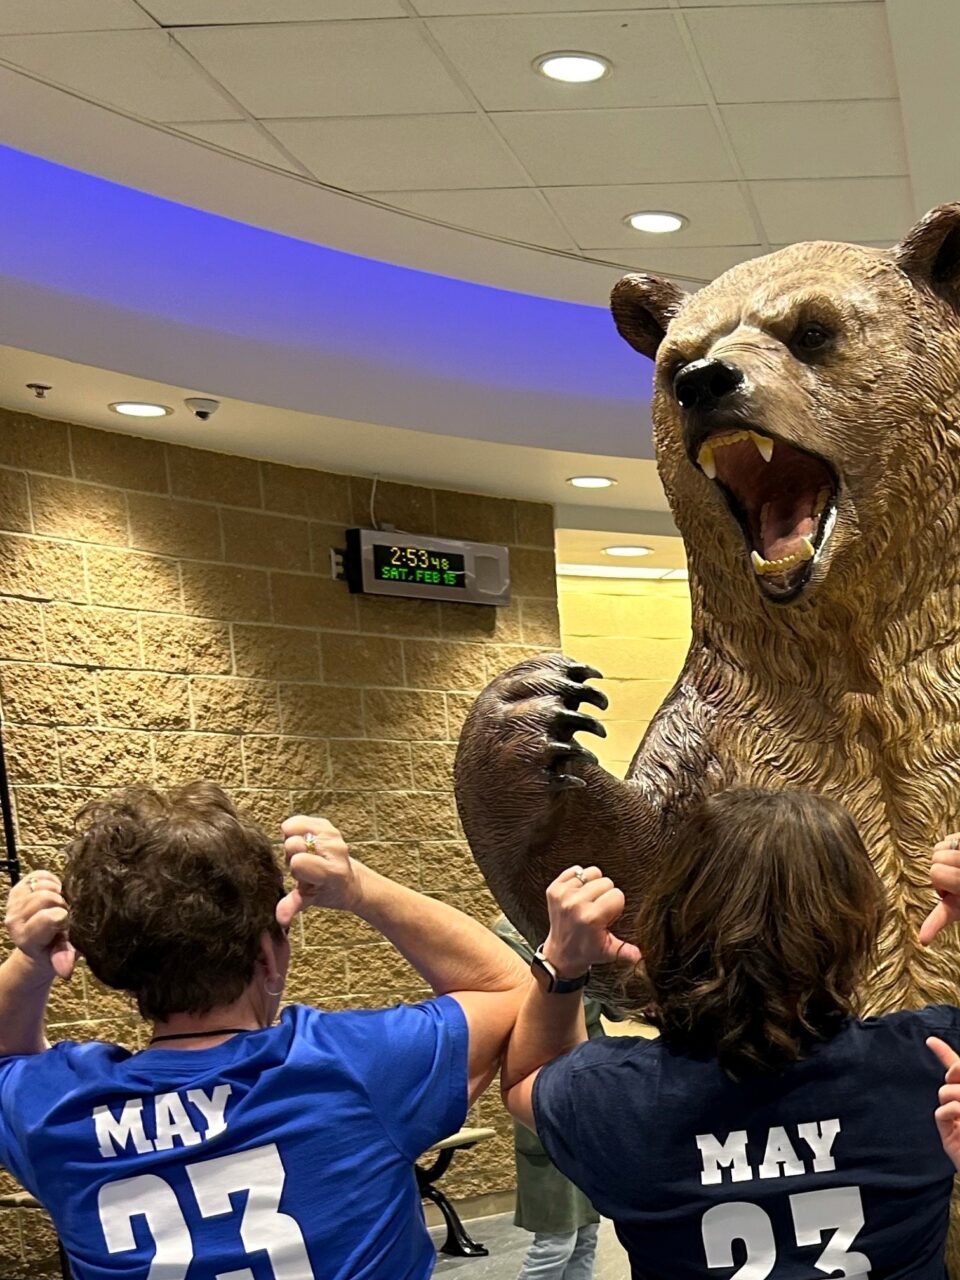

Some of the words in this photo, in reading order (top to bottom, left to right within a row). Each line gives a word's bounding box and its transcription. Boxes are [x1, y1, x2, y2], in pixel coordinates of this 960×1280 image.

[390, 547, 429, 567] 2:53
[431, 557, 450, 570] 48
[416, 570, 441, 583] FEB
[92, 1083, 233, 1158] MAY
[695, 1118, 841, 1186] MAY
